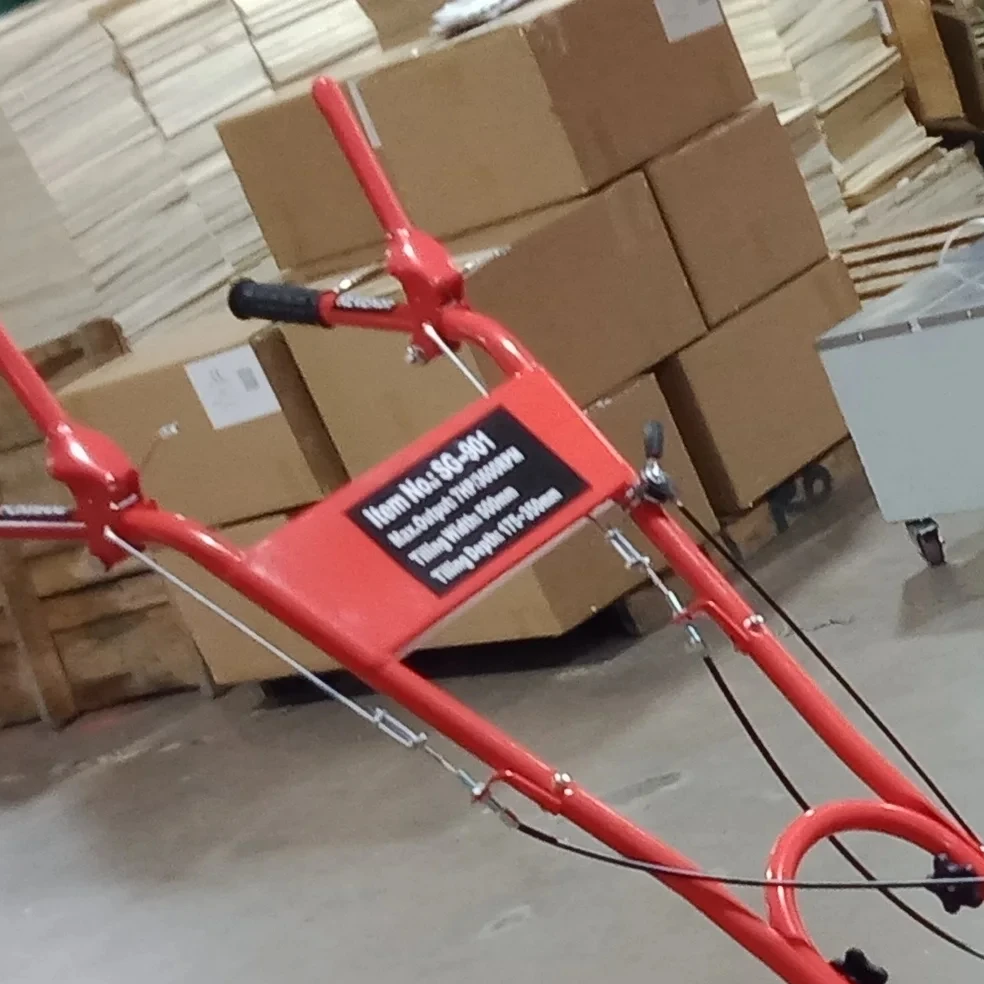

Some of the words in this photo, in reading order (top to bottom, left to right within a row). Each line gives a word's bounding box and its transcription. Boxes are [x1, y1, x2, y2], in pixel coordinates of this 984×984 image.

[362, 493, 411, 530] Item
[399, 471, 443, 504] No.:
[430, 429, 497, 480] SG-901
